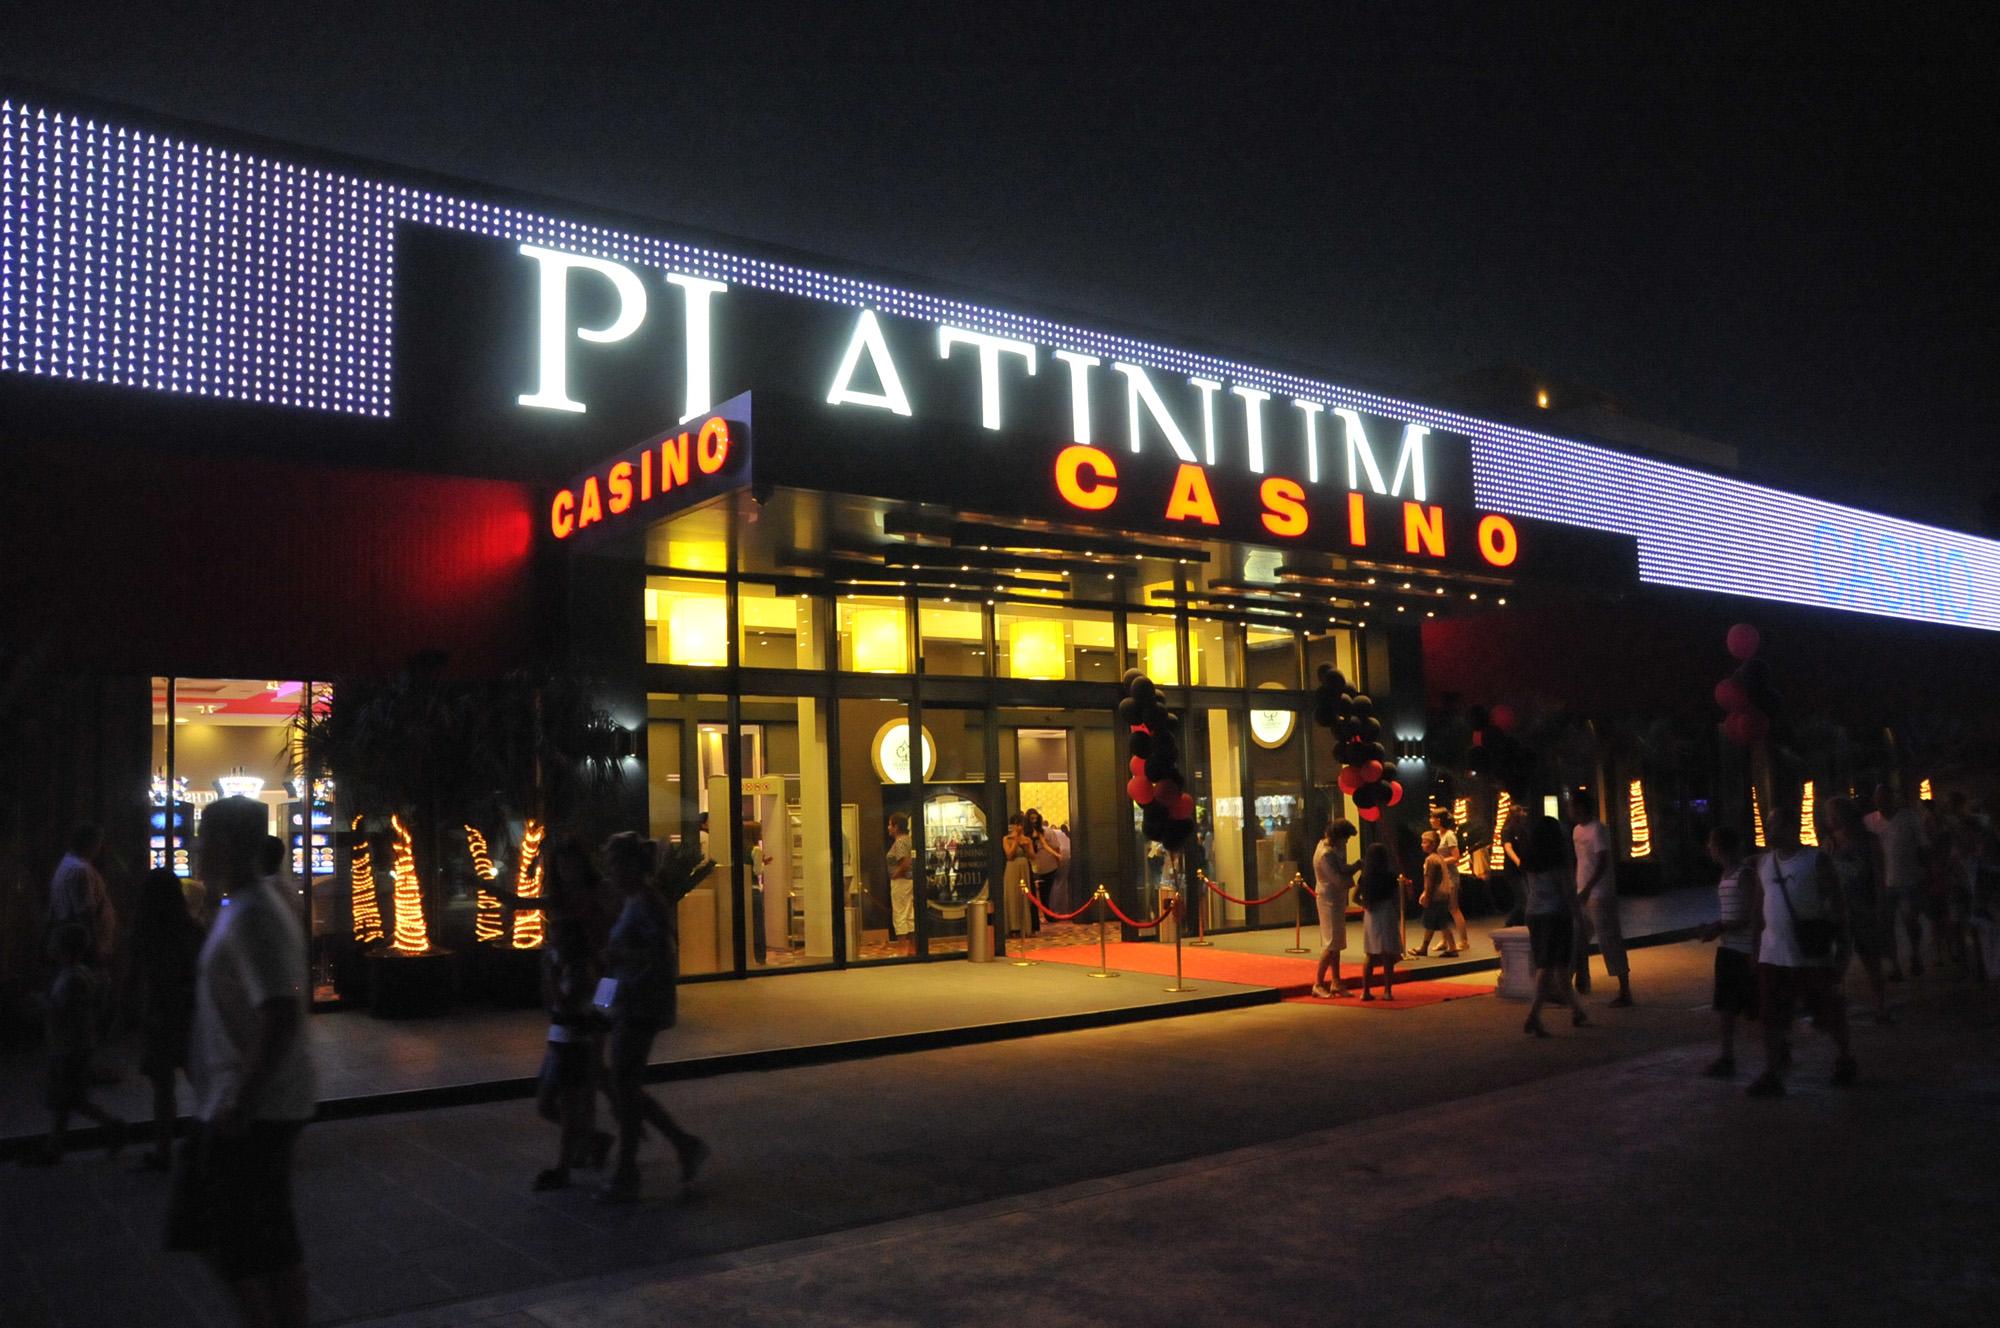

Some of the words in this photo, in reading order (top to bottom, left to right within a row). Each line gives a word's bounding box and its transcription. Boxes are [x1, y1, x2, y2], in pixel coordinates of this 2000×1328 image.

[518, 244, 1431, 502] PLATINUM
[550, 416, 730, 540] CASINO
[1054, 444, 1518, 567] CASINO
[1812, 520, 1973, 621] CASINO
